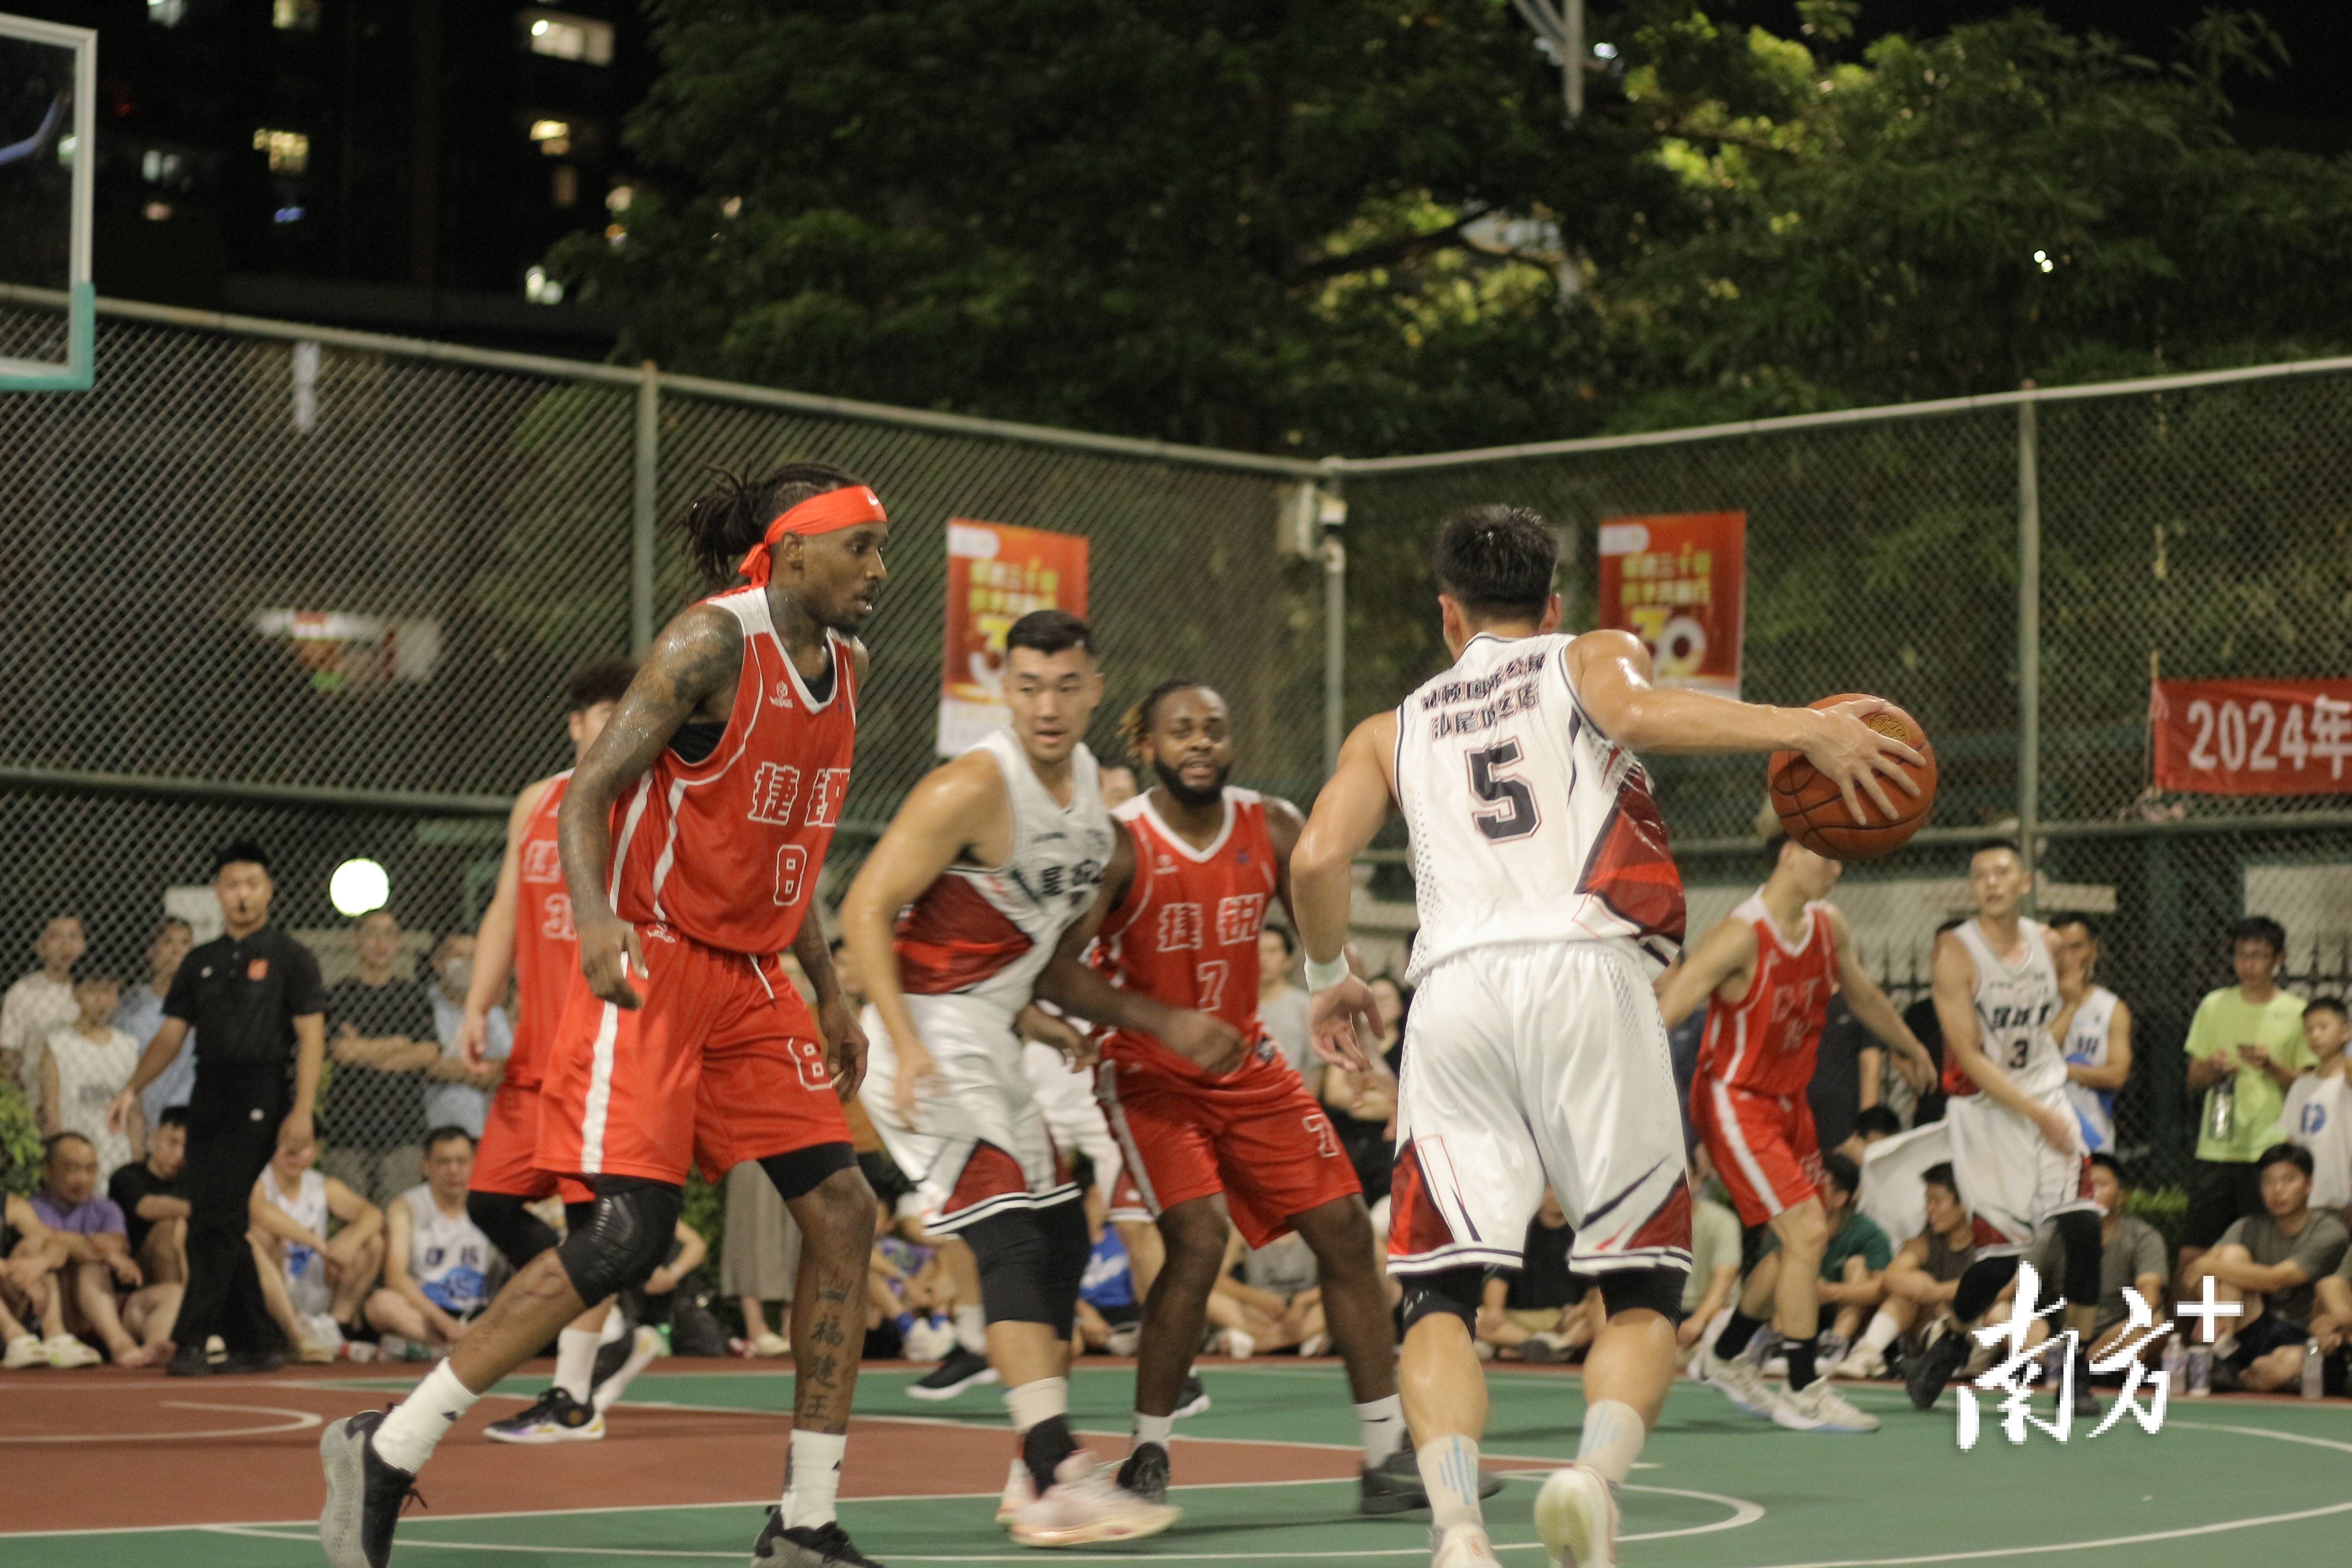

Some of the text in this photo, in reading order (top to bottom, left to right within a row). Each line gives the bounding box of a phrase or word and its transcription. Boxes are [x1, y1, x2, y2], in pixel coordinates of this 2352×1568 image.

[2187, 693, 2352, 780] 2024年
[1465, 737, 1542, 845] 5
[773, 844, 807, 906] 8
[1197, 959, 1229, 1013] 7
[786, 1037, 835, 1092] 8
[2009, 1039, 2029, 1068] 3
[1301, 1112, 1340, 1158] 7
